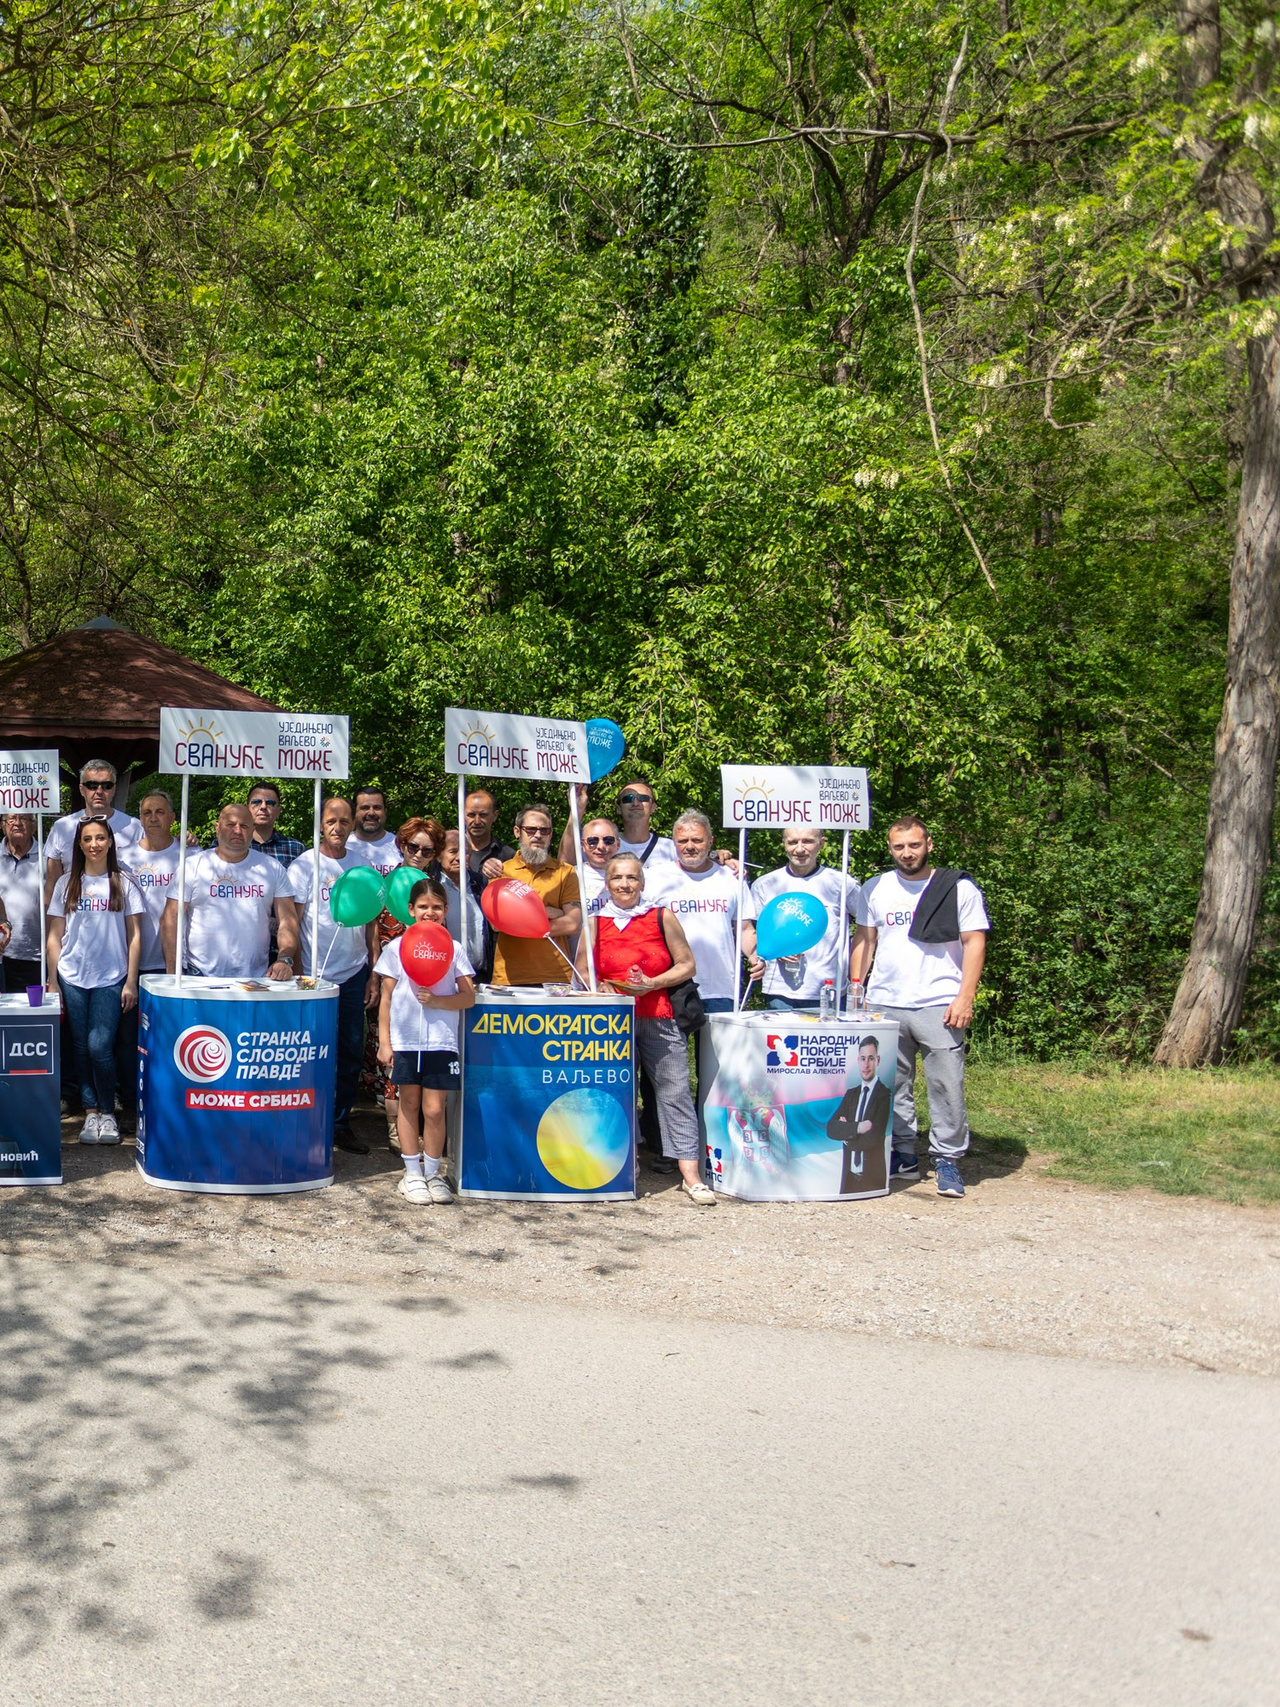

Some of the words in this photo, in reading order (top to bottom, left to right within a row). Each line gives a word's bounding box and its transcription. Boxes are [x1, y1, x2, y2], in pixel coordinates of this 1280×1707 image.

[279, 721, 333, 735] УЈЕДИЊЕНО
[535, 727, 576, 741] УЈЕДИЊЕНО
[278, 735, 316, 746] ВАЉЕВО
[536, 740, 565, 752] ВАЉЕВО
[175, 742, 264, 769] СВАНУЋЕ
[278, 749, 332, 771] МОЖЕ
[457, 743, 529, 770] СВАНУЋЕ
[537, 752, 579, 774] МОЖЕ
[819, 778, 861, 790] УЈЕДИЊЕНО
[819, 790, 849, 801] ВАЉЕВО
[733, 800, 812, 822] СВАНУЋЕ
[820, 803, 861, 824] МОЖЕ
[210, 884, 264, 899] СВАНУЋЕ
[670, 899, 728, 914] СВАНУЋЕ
[413, 949, 447, 962] СВАНУЋЕ
[471, 1013, 631, 1035] ДЕМОКРАТСКА
[237, 1030, 311, 1047] СТРАНКА
[800, 1035, 860, 1047] НАРОДНИ
[9, 1042, 48, 1057] ДСС
[236, 1046, 316, 1063] СЛОБОДЕ
[318, 1045, 329, 1059] И
[542, 1040, 631, 1061] СТРАНКА
[800, 1046, 848, 1056] ПОКРЕТ
[448, 1061, 460, 1075] 13
[800, 1057, 846, 1067] СРБИЈЕ
[236, 1063, 302, 1080] ПРАВДЕ
[542, 1069, 631, 1084] ВАЉЕВО
[189, 1093, 245, 1107] МОЖЕ
[249, 1092, 311, 1107] СРБИЈА
[705, 1170, 723, 1183] НПС
